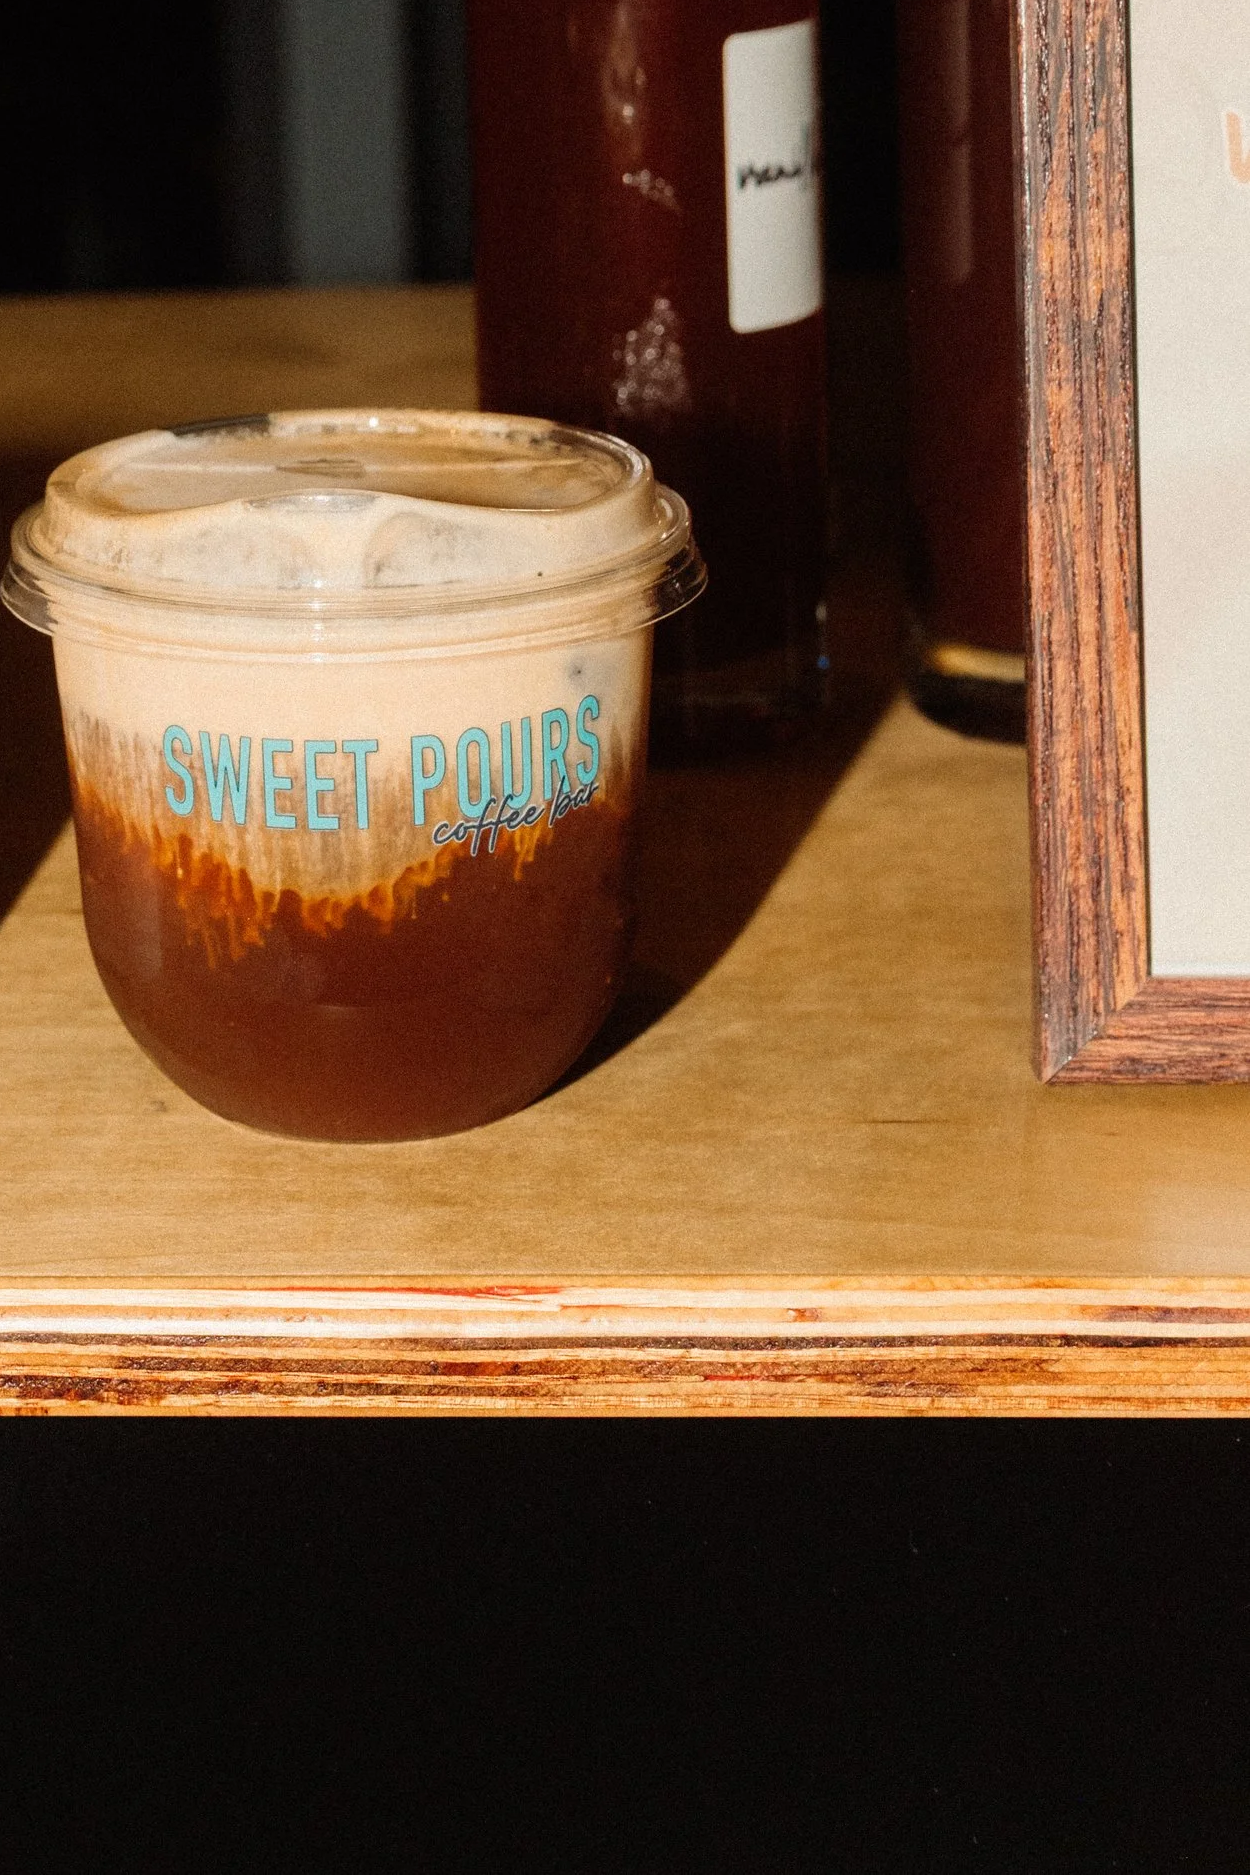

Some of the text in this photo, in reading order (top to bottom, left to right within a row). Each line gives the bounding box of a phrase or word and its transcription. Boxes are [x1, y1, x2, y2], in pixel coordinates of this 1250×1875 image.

[162, 694, 600, 831] SWEET POURS
[432, 774, 600, 857] coffee bar
